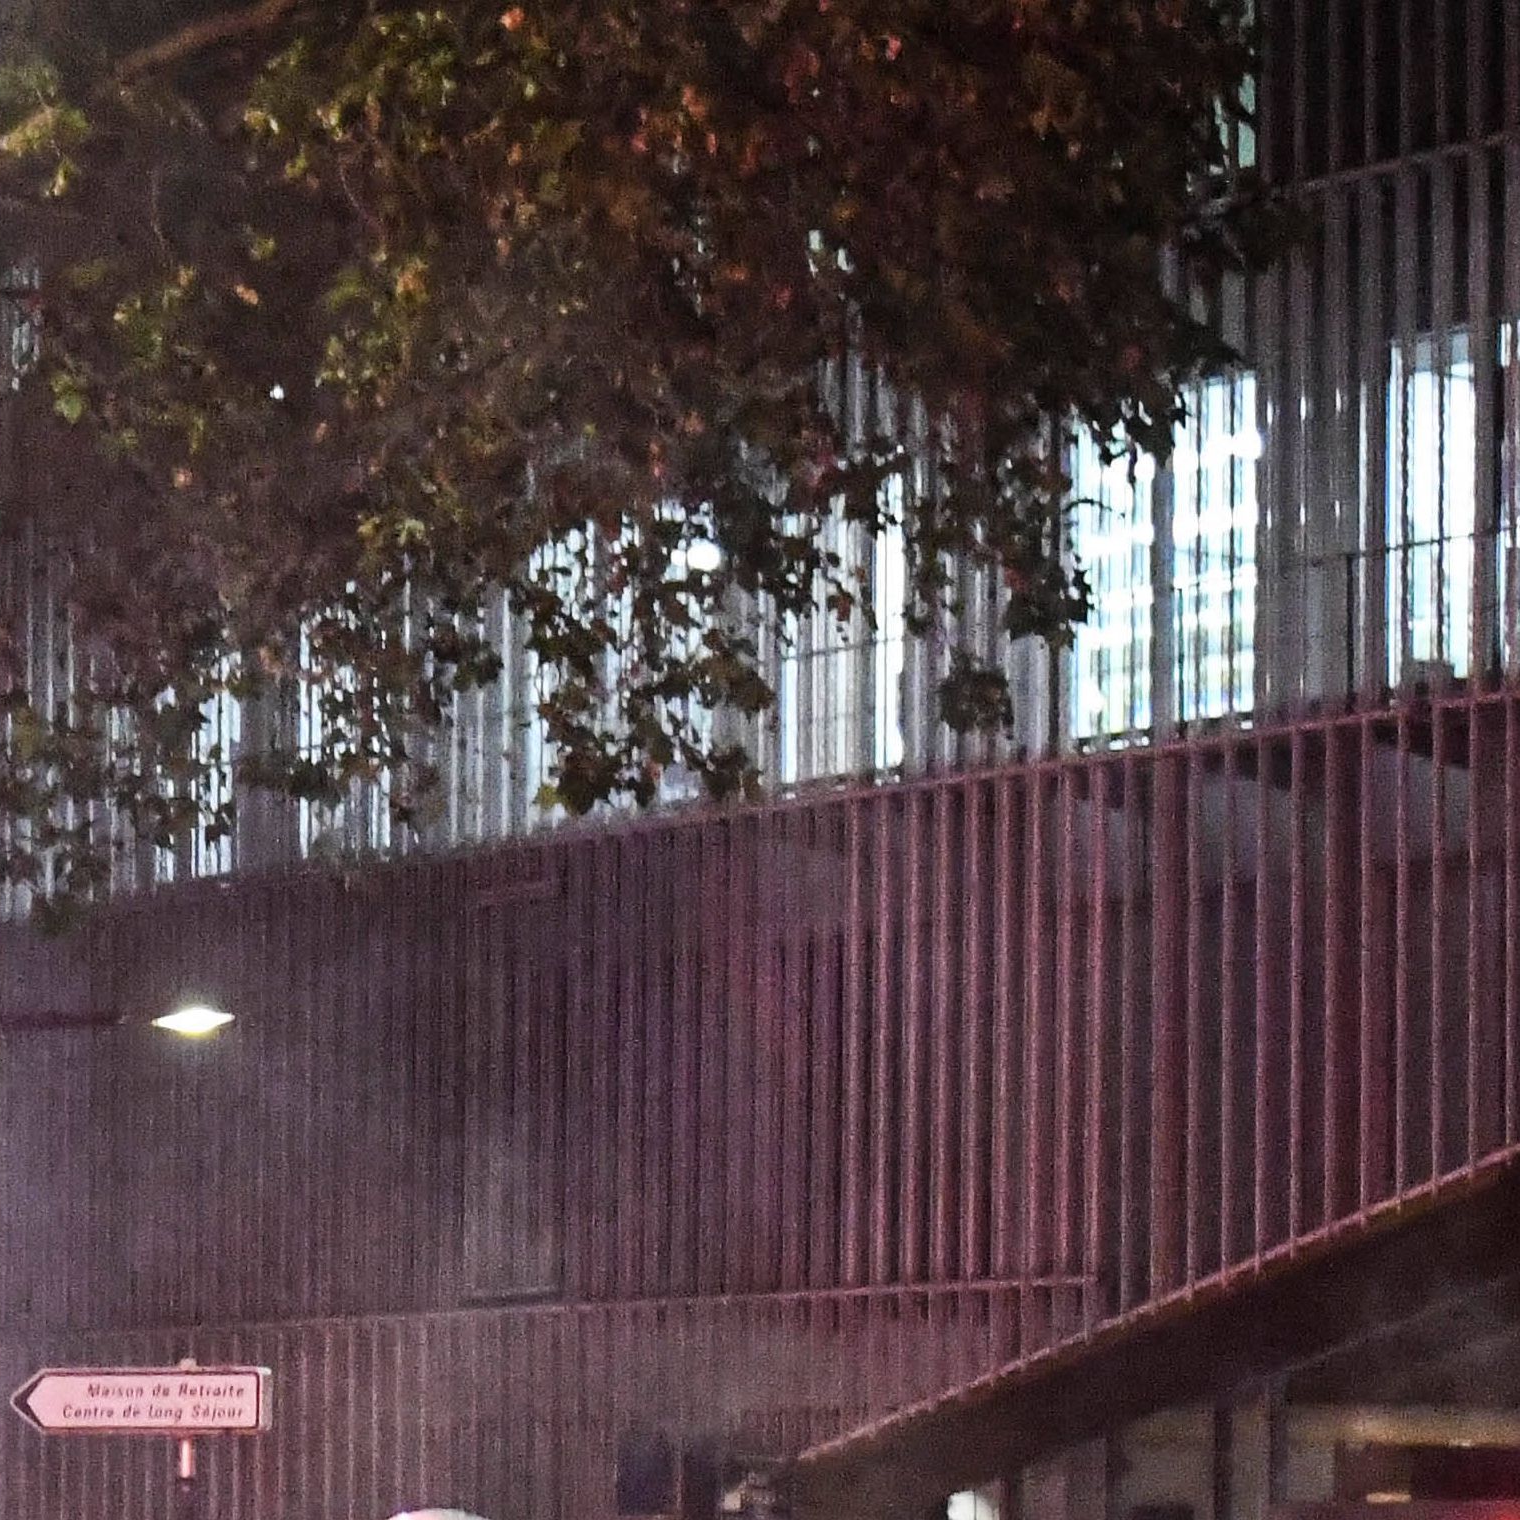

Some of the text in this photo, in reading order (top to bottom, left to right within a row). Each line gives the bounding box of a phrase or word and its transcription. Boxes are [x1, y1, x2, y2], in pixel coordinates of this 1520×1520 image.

[87, 1383, 245, 1398] Maison de Retraite
[62, 1405, 115, 1419] Centre
[122, 1405, 141, 1419] de
